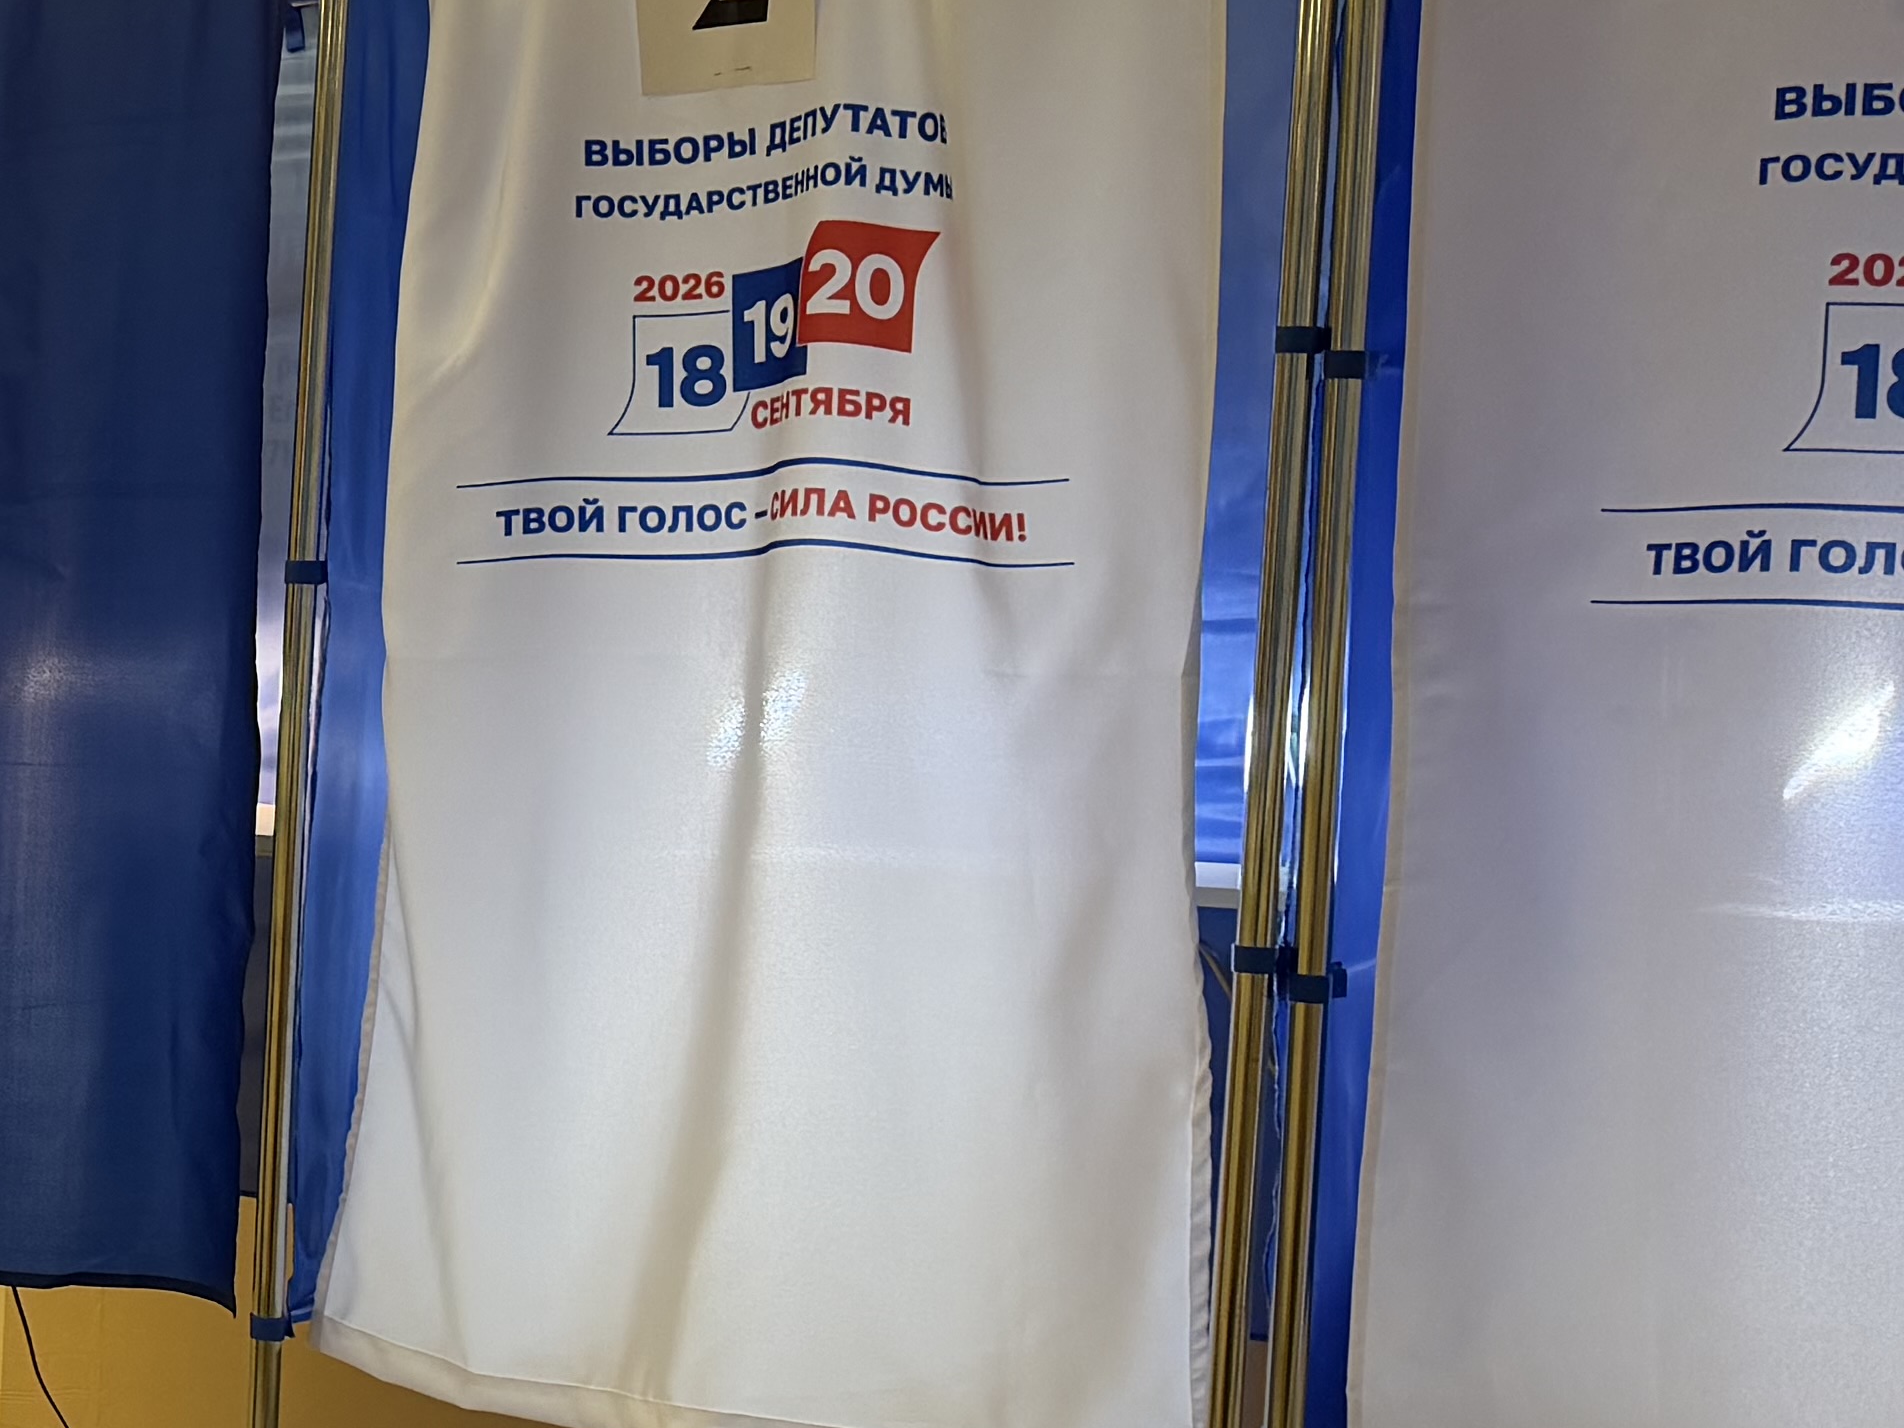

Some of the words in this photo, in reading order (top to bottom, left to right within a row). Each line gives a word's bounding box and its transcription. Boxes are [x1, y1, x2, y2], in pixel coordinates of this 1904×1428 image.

[1774, 82, 1904, 121] ВЫБ
[584, 127, 757, 167] ВЫБОРЫ
[575, 155, 867, 221] ГОСУДАРСТВЕННОЙ
[633, 271, 725, 303] 2026
[646, 344, 727, 408] 18
[743, 293, 795, 364] 19
[805, 248, 905, 321] 20
[750, 386, 912, 430] СЕНТЯБРЯ
[496, 498, 605, 537] ТВОЙ
[617, 501, 748, 534] ГОЛОС
[769, 487, 857, 521] СИЛА
[868, 492, 1028, 544] РОССИИ!
[1646, 529, 1772, 576] ТВОЙ
[1789, 538, 1904, 576] ГОЛ
